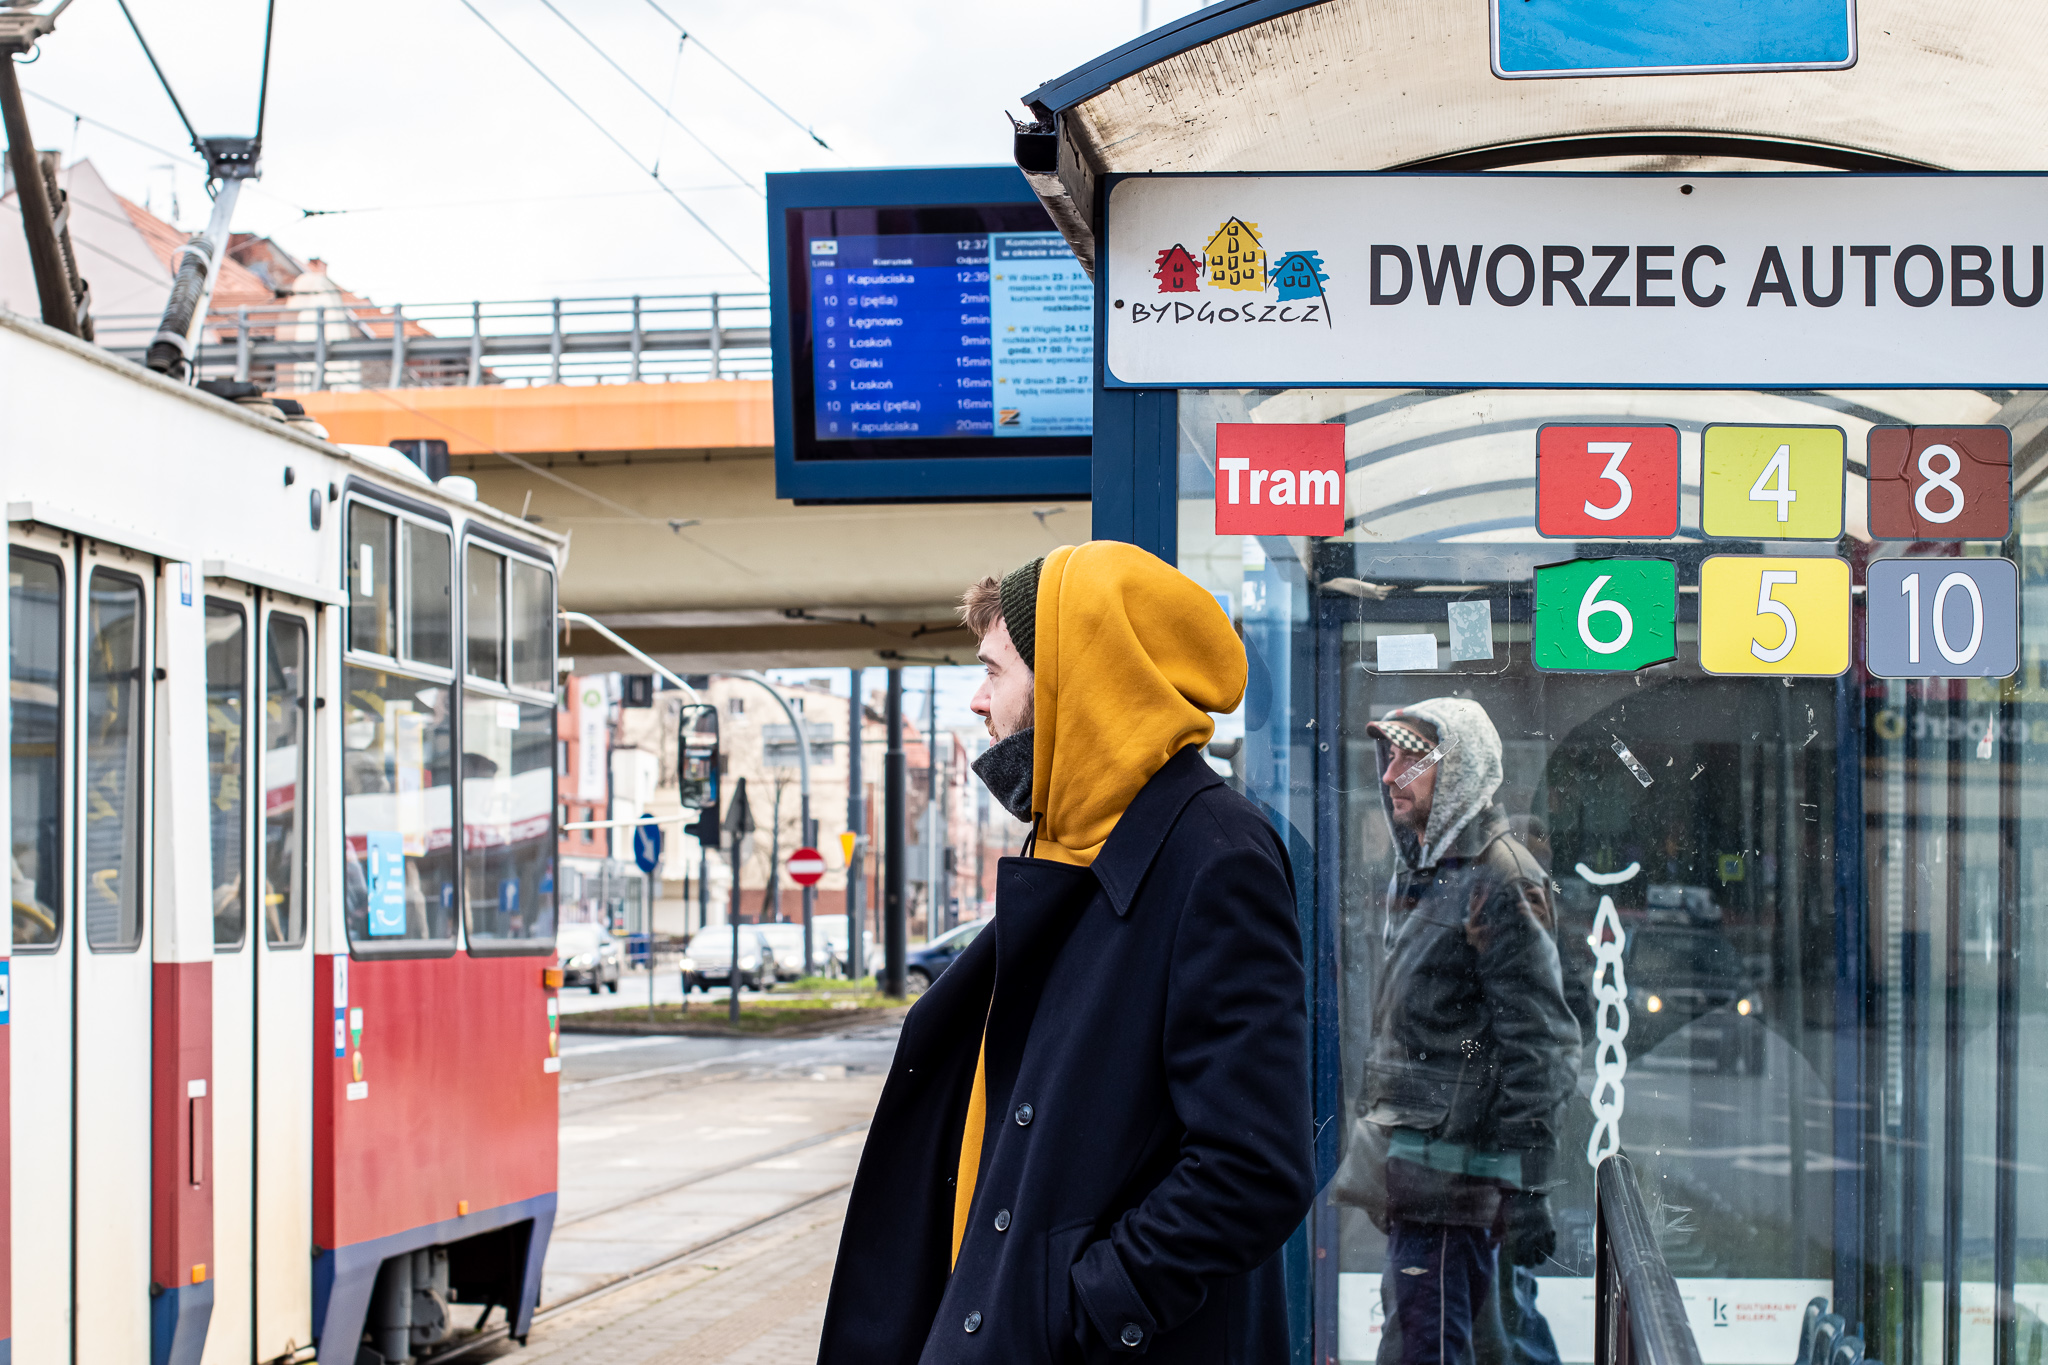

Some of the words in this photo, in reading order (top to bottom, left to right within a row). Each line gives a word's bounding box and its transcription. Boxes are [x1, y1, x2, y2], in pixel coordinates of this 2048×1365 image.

[957, 239, 988, 250] 12:37
[825, 274, 834, 285] 8
[847, 273, 915, 286] Kapuściska
[956, 271, 990, 282] 12:39
[1369, 243, 1726, 308] DWORZEC
[1747, 243, 2044, 308] AUTOBU
[823, 295, 838, 306] 10
[860, 295, 898, 308] (pętla)
[960, 293, 990, 304] 2min
[1132, 301, 1320, 324] BYDGOSZCZ
[826, 316, 835, 328] 6
[848, 316, 903, 329] Łęgnowo
[961, 314, 990, 325] 5min
[827, 337, 836, 348] 5
[849, 336, 892, 348] Łoskoń
[961, 335, 991, 346] 9min
[827, 358, 836, 369] 4
[850, 357, 883, 369] Glinki
[956, 356, 991, 367] 15min
[828, 379, 837, 391] 3
[850, 378, 893, 390] Łoskoń
[956, 377, 992, 388] 16min
[826, 400, 841, 412] 10
[883, 399, 921, 413] (pętla)
[956, 398, 992, 409] 16min
[829, 421, 838, 433] 8
[851, 420, 919, 434] Kapuściska
[956, 419, 993, 431] 20min
[1218, 457, 1341, 506] Tram
[1583, 441, 1633, 521] 3
[1748, 443, 1797, 522] 4
[1914, 443, 1965, 524] 8
[1577, 574, 1634, 654] 6
[1750, 569, 1797, 663] 5
[1900, 571, 1984, 665] 10
